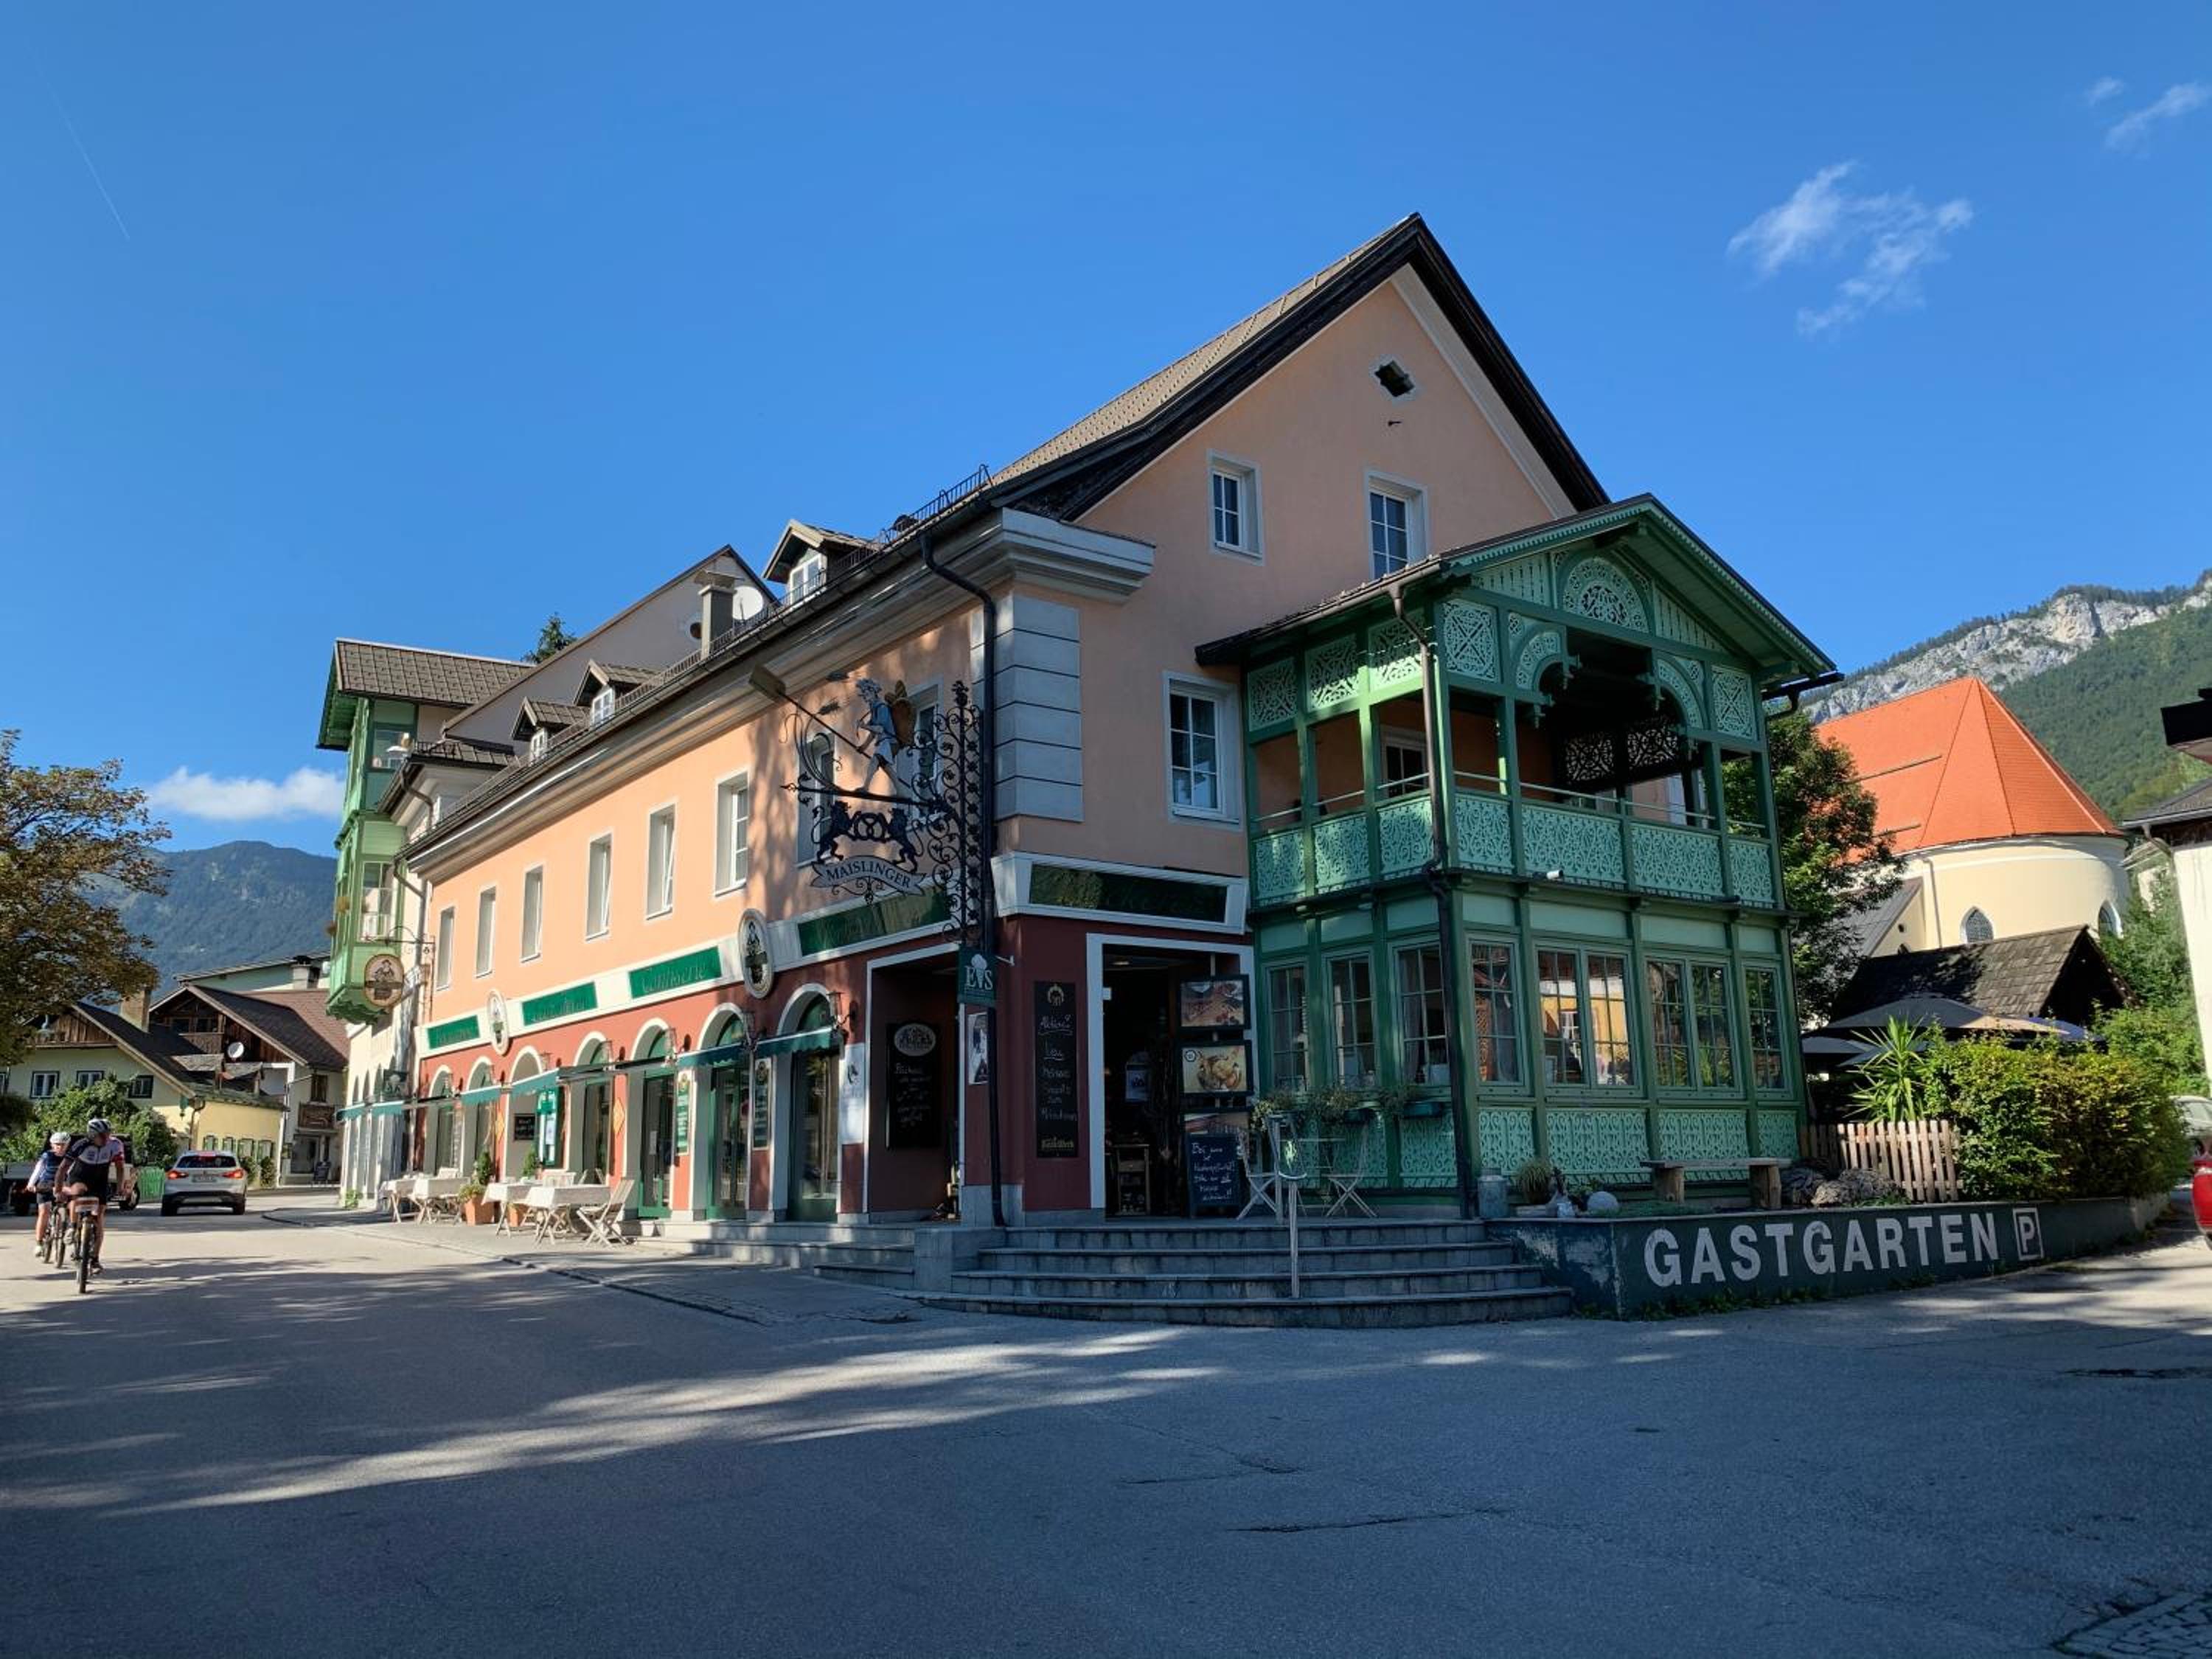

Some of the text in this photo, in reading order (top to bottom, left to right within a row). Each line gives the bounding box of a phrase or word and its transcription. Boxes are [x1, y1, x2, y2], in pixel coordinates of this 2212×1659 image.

[825, 860, 911, 888] MAISLINGER
[1643, 1211, 2039, 1287] GASTGARTEN P
